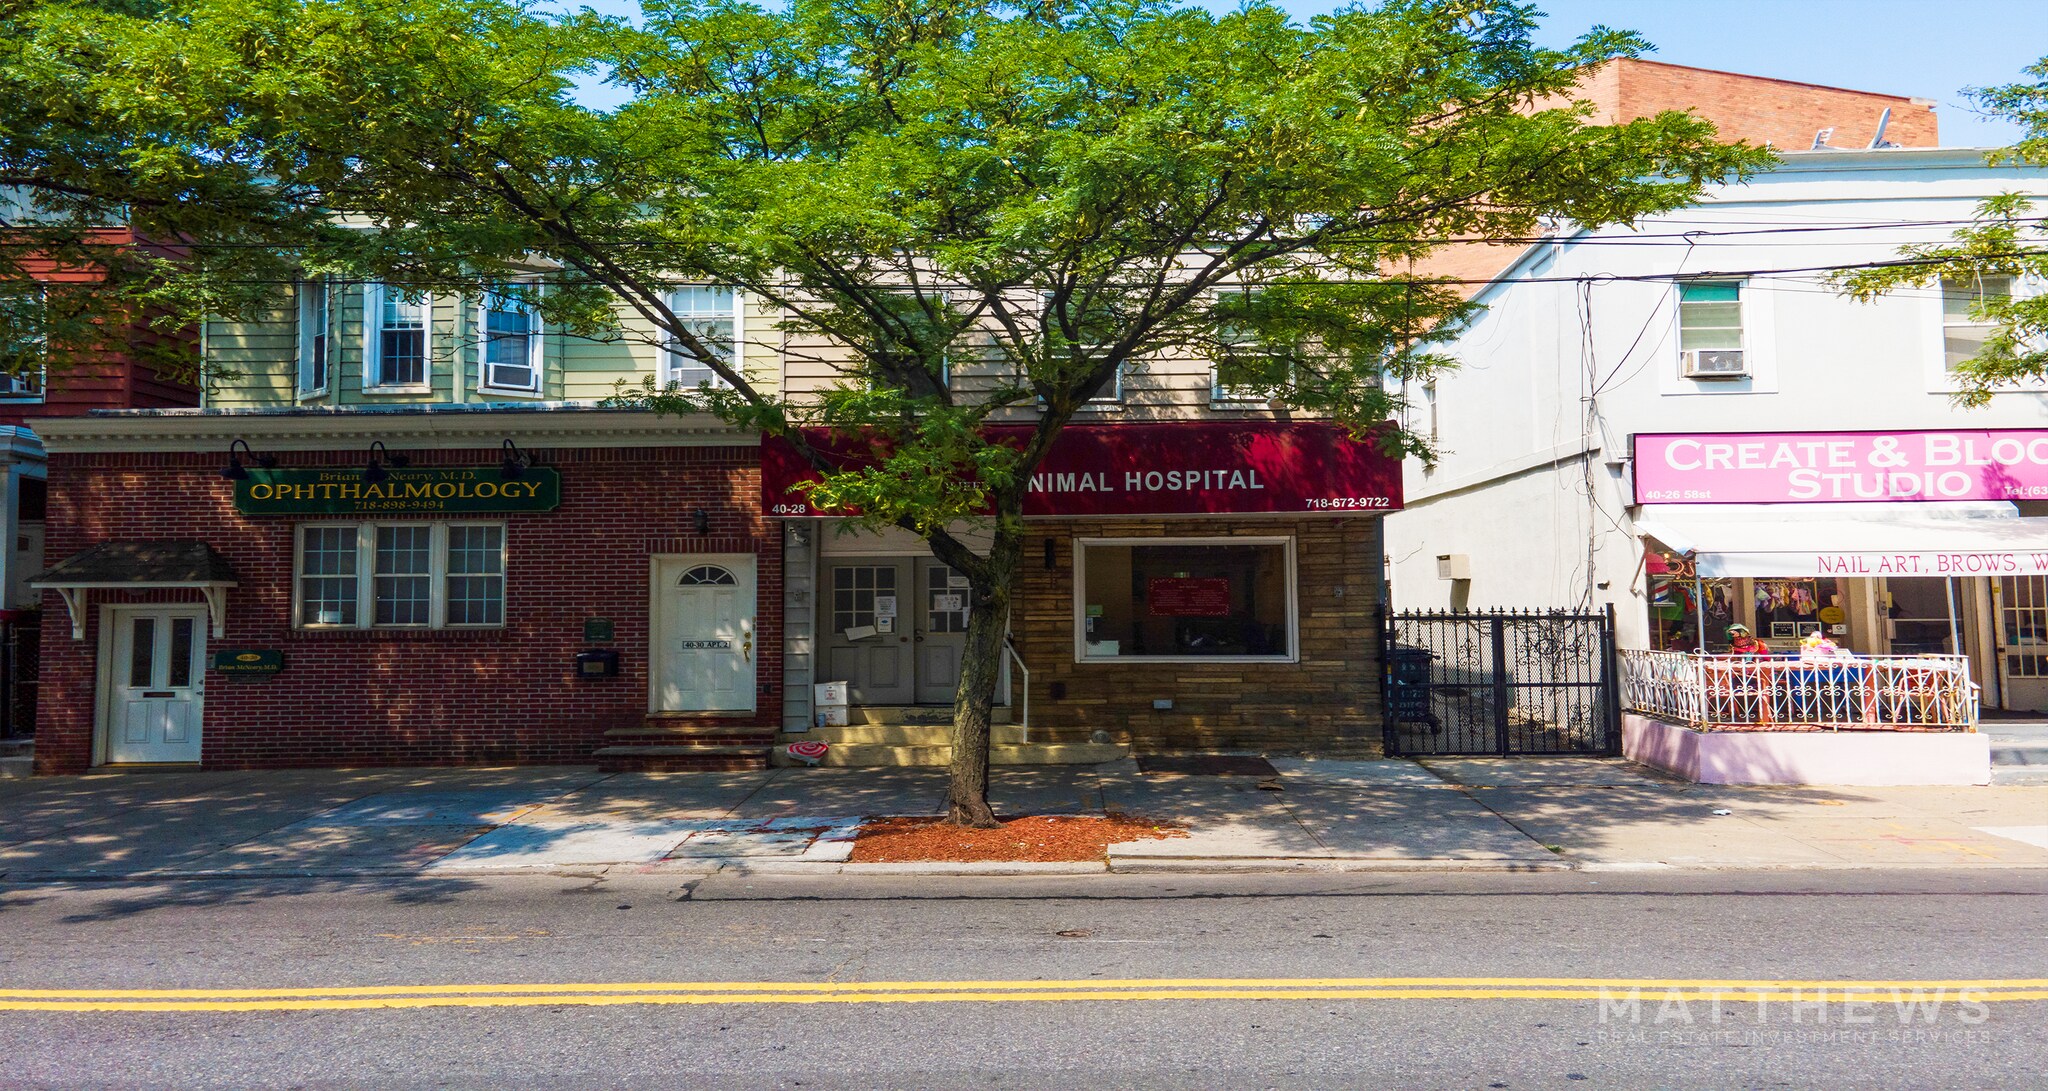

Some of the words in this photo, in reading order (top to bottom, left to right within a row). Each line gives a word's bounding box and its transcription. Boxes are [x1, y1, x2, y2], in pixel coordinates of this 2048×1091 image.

[1664, 439, 1856, 471] CREATE
[1867, 435, 1910, 468] &
[319, 472, 361, 482] Brian
[1027, 471, 1114, 493] NIMAL
[1125, 469, 1265, 492] HOSPITAL
[1788, 468, 1972, 499] STUDIO
[249, 481, 542, 500] OPHTHALMOLOGY
[1645, 490, 1681, 499] 40-26
[1684, 490, 1712, 499] 58st
[354, 500, 445, 511] 718-898-9494
[771, 504, 807, 514] 40-28
[1305, 497, 1390, 509] 718-672-9722
[1817, 555, 1870, 574] NAIL
[1878, 555, 1929, 574] ART,
[1937, 553, 2023, 574] BROWS,
